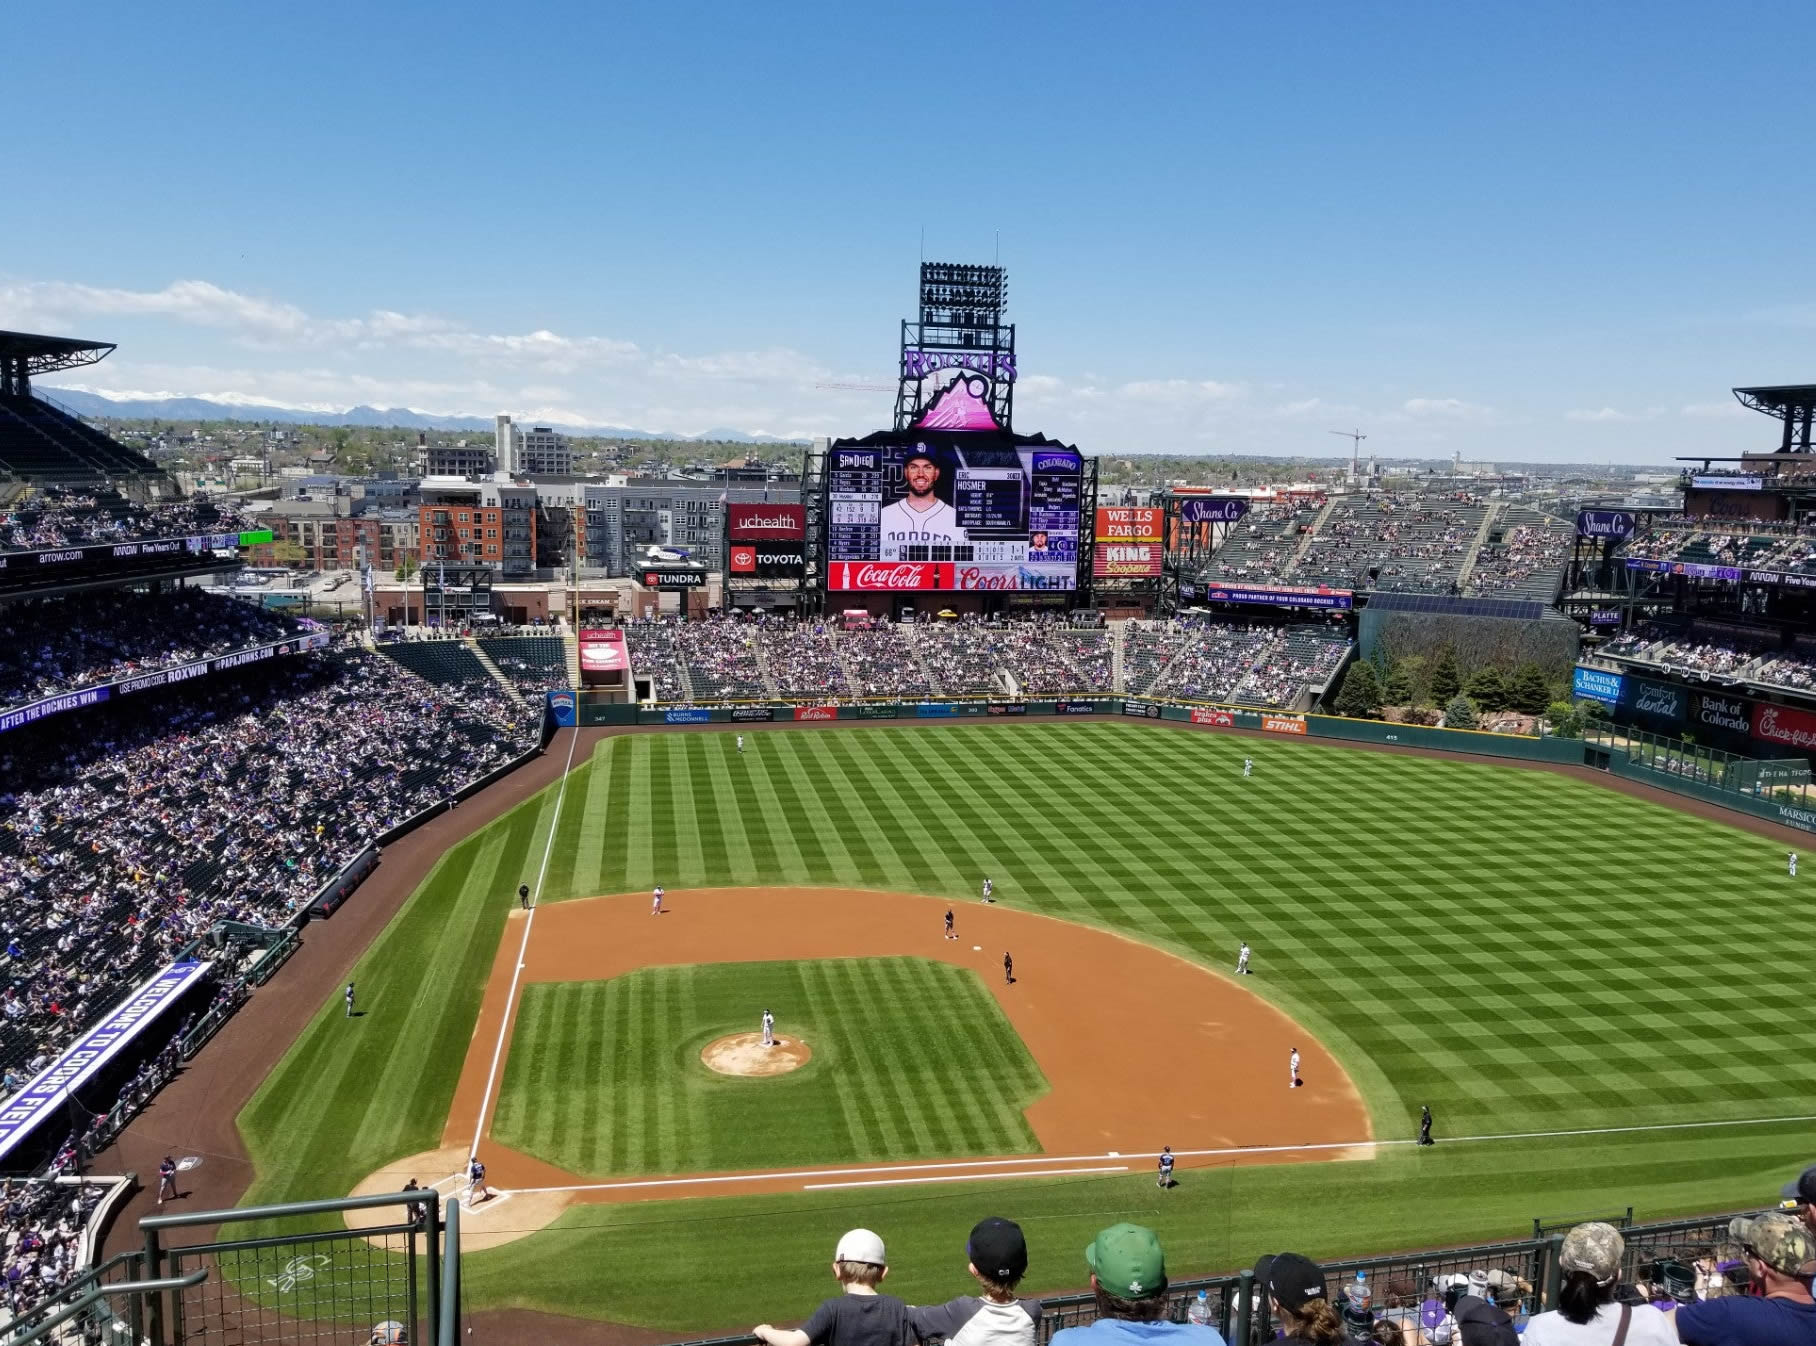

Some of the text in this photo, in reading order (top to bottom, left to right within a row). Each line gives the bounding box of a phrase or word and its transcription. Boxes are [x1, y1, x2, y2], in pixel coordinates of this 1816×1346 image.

[854, 454, 874, 469] DIEGO
[1038, 457, 1076, 470] COLORADO
[957, 480, 987, 490] HOSMER
[1107, 510, 1153, 522] WELLS
[1192, 501, 1238, 521] Shane Co
[739, 513, 795, 528] uchealth
[1583, 512, 1624, 536] Shane Co
[1107, 525, 1152, 536] FARGO
[142, 544, 154, 553] Five
[155, 543, 169, 552] Years
[169, 542, 180, 551] Out
[1106, 546, 1151, 561] KING
[39, 550, 83, 563] arrow.com
[756, 554, 803, 565] TOYOTA
[857, 563, 925, 587] Coca-Cola
[1105, 562, 1151, 575] Soopers
[658, 574, 701, 584] TUNDRA
[960, 566, 1071, 589] Coors LIGHT
[1750, 572, 1779, 583] ARROW
[1785, 575, 1800, 585] Five
[1289, 596, 1313, 604] COLORADO
[119, 682, 132, 694] USE
[131, 677, 151, 691] PROMO
[168, 662, 208, 683] ROXWIN
[1583, 671, 1619, 687] BACHUS &
[1576, 679, 1612, 695] SCHANKER
[1639, 683, 1676, 700] Comfort
[0, 691, 98, 730] AFTER THE ROCKIES WIN
[1636, 694, 1679, 717] dental
[1702, 696, 1742, 716] Bank of
[1265, 720, 1302, 732] STIHL
[1701, 710, 1750, 732] Colorado
[104, 978, 182, 1031] WELCOME
[86, 1032, 120, 1048] TO
[32, 1051, 100, 1094] COORS
